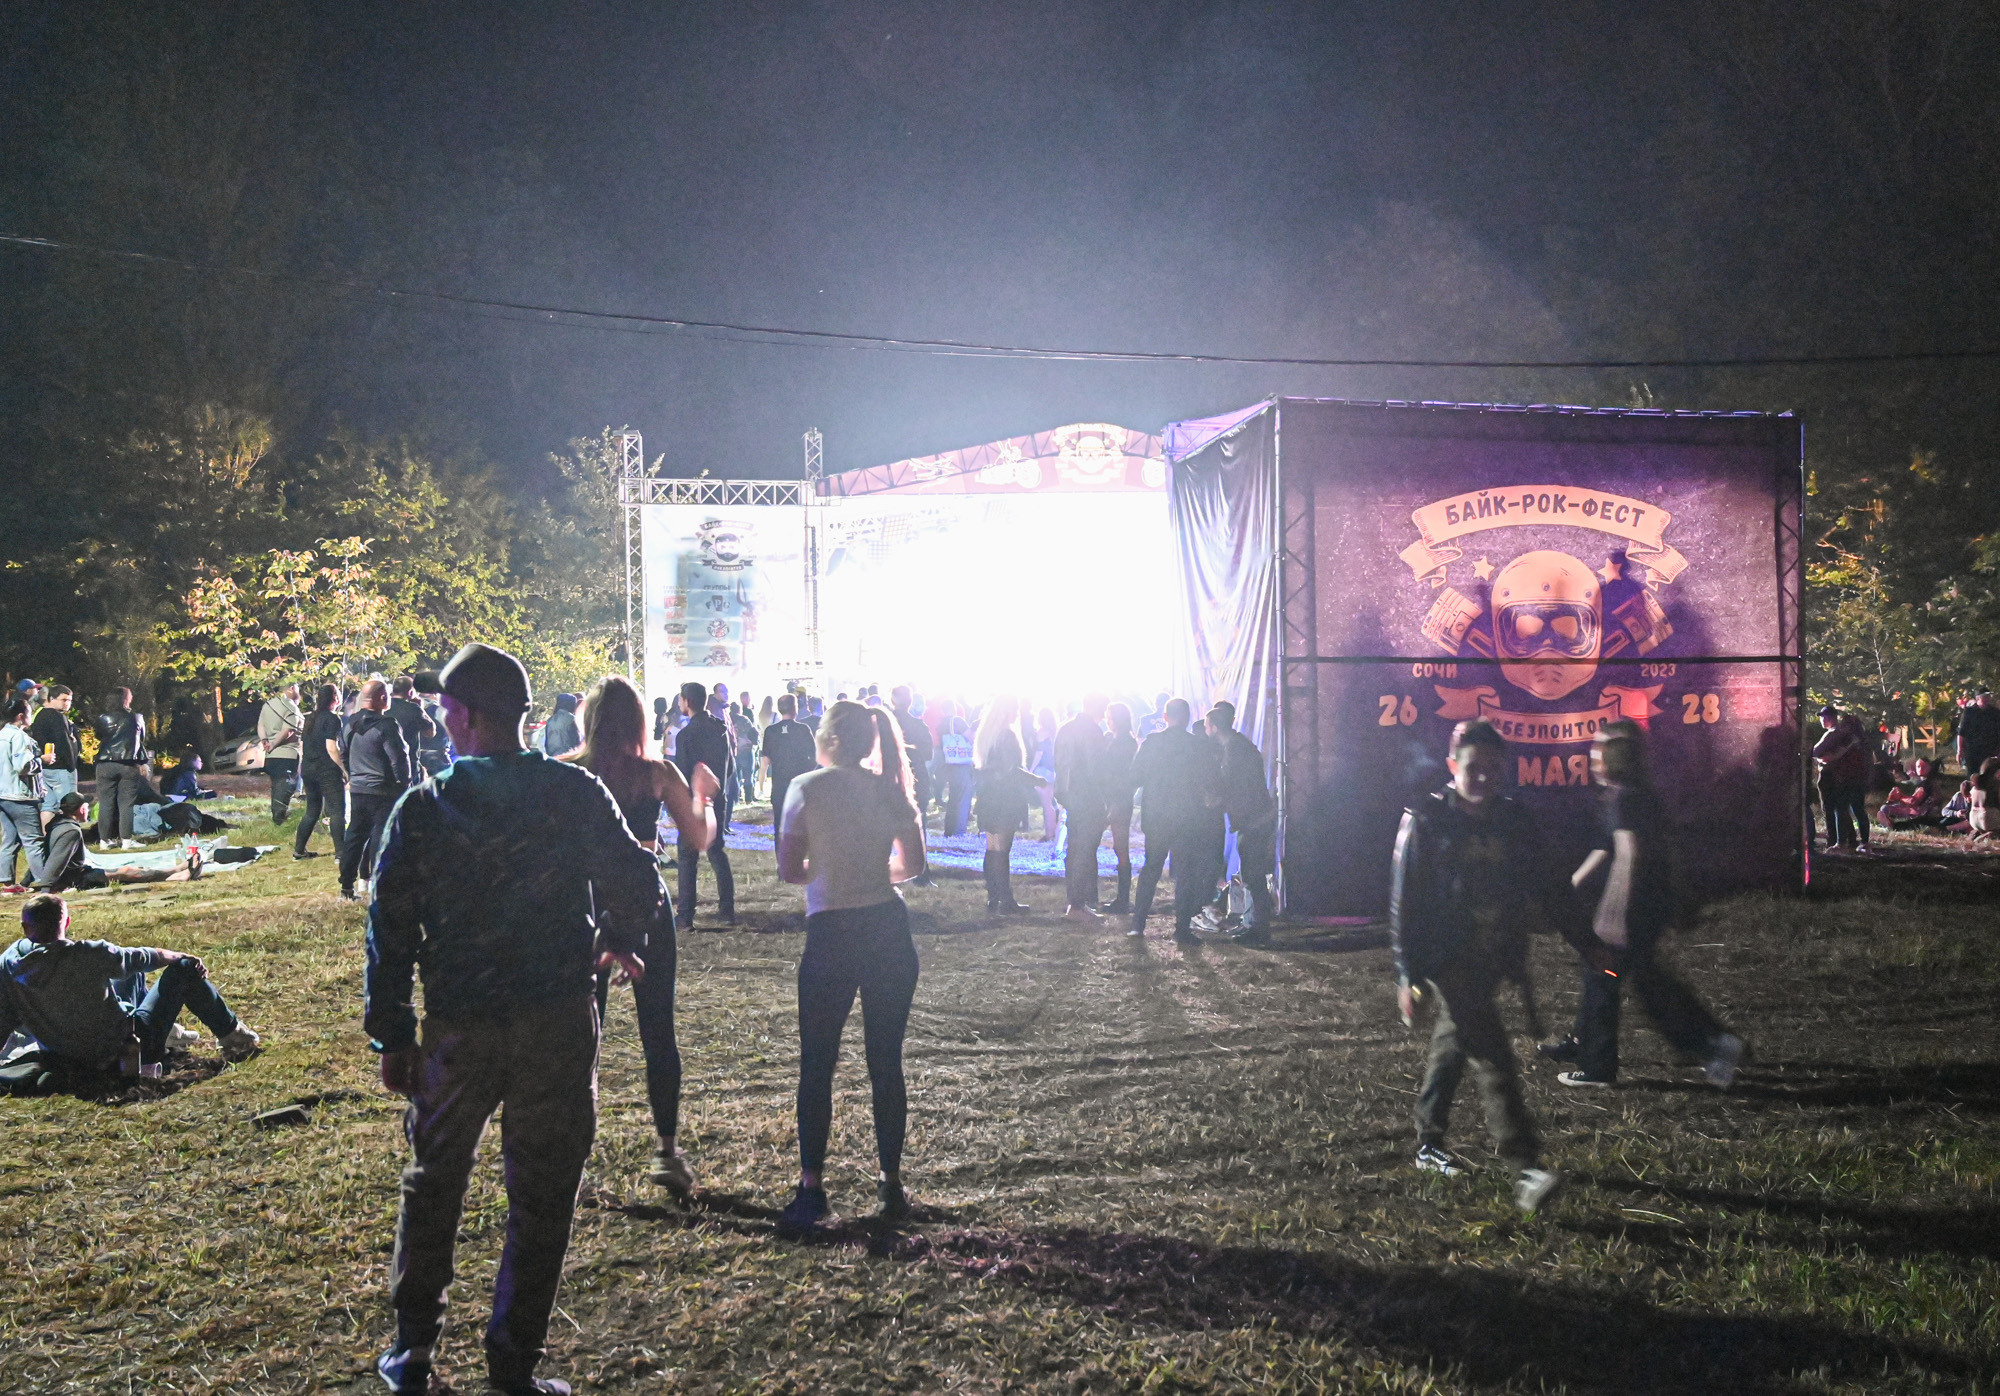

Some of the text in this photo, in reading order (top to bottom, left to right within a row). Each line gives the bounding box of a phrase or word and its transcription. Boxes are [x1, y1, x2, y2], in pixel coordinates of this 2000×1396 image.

[1445, 491, 1646, 528] БАЙК-РОК-ФЕСТ
[1412, 662, 1458, 678] СОЧИ
[1641, 663, 1677, 678] 2023
[1378, 694, 1418, 727] 26
[1682, 693, 1721, 725] 28
[1517, 754, 1589, 787] МАЯ
